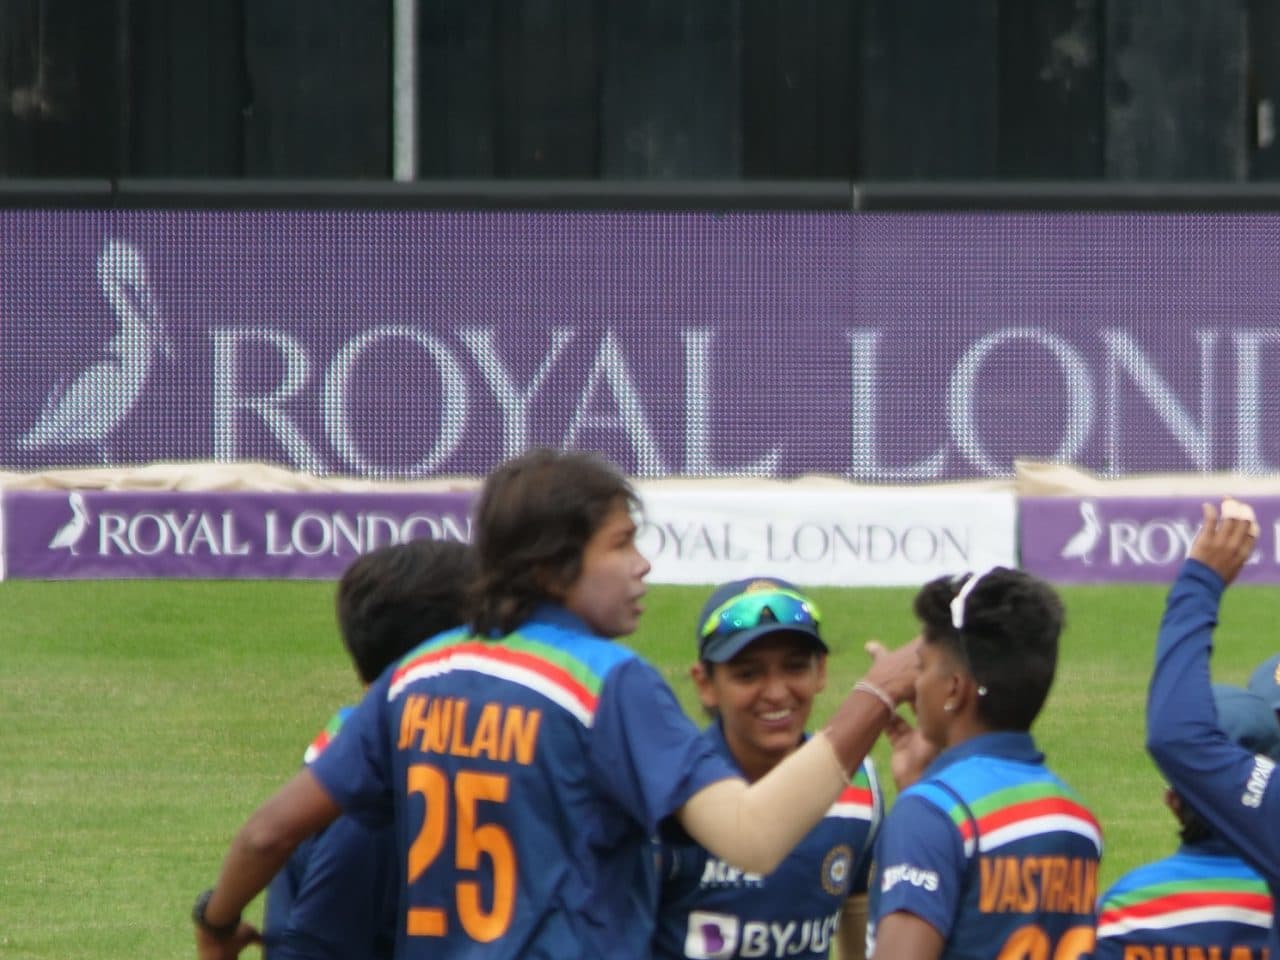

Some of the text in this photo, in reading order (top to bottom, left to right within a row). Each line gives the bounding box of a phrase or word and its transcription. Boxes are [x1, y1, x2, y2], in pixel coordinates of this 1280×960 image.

[209, 326, 782, 480] ROYAL
[98, 511, 249, 556] ROYAL
[635, 520, 970, 565] OYAL LONDON
[407, 764, 516, 943] 25
